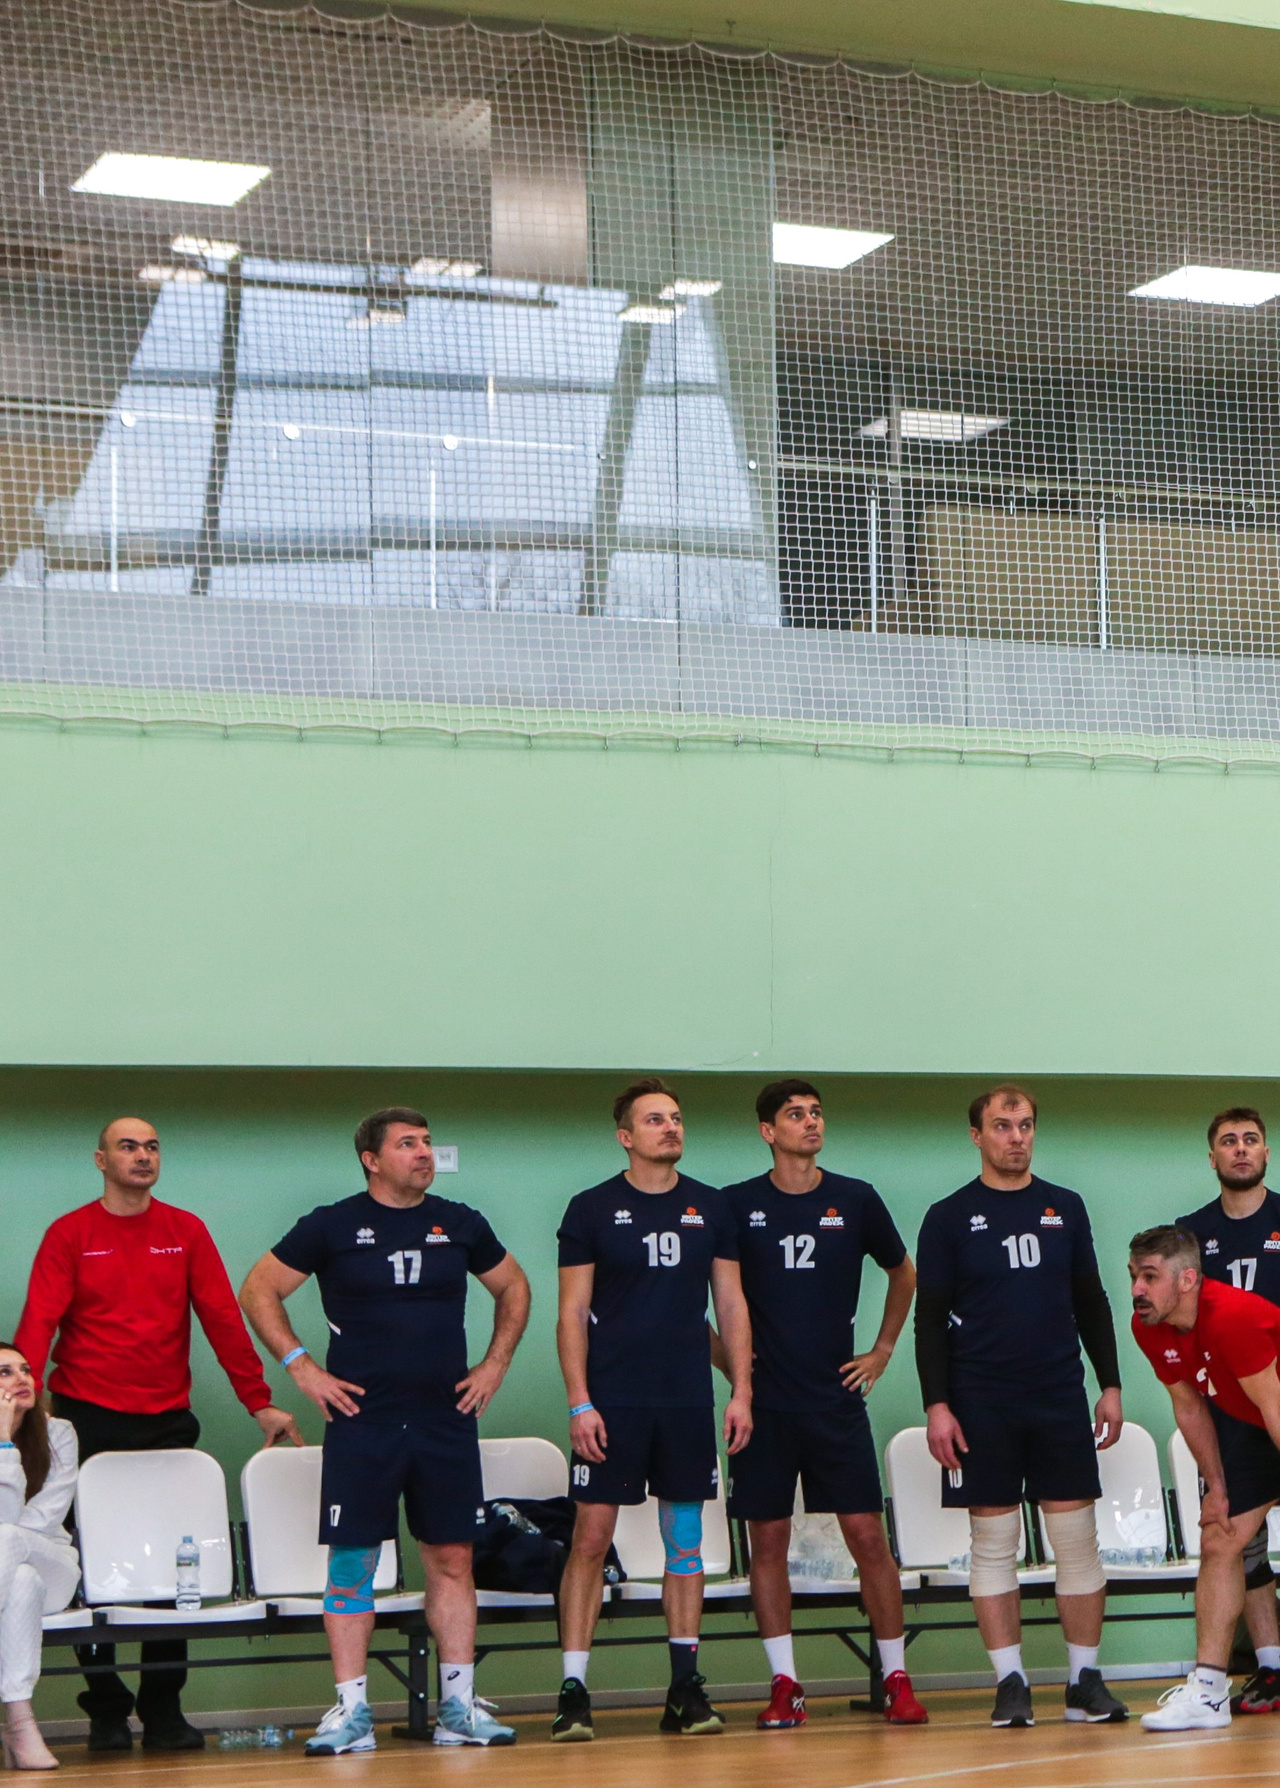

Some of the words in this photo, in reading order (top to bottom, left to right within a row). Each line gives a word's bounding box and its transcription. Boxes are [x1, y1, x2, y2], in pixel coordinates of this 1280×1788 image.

[642, 1232, 681, 1267] 19
[779, 1234, 816, 1269] 12
[1001, 1233, 1041, 1269] 10
[387, 1250, 422, 1285] 17
[1226, 1257, 1257, 1292] 17
[572, 1464, 590, 1487] 19
[948, 1468, 963, 1489] 10
[329, 1504, 342, 1527] 17
